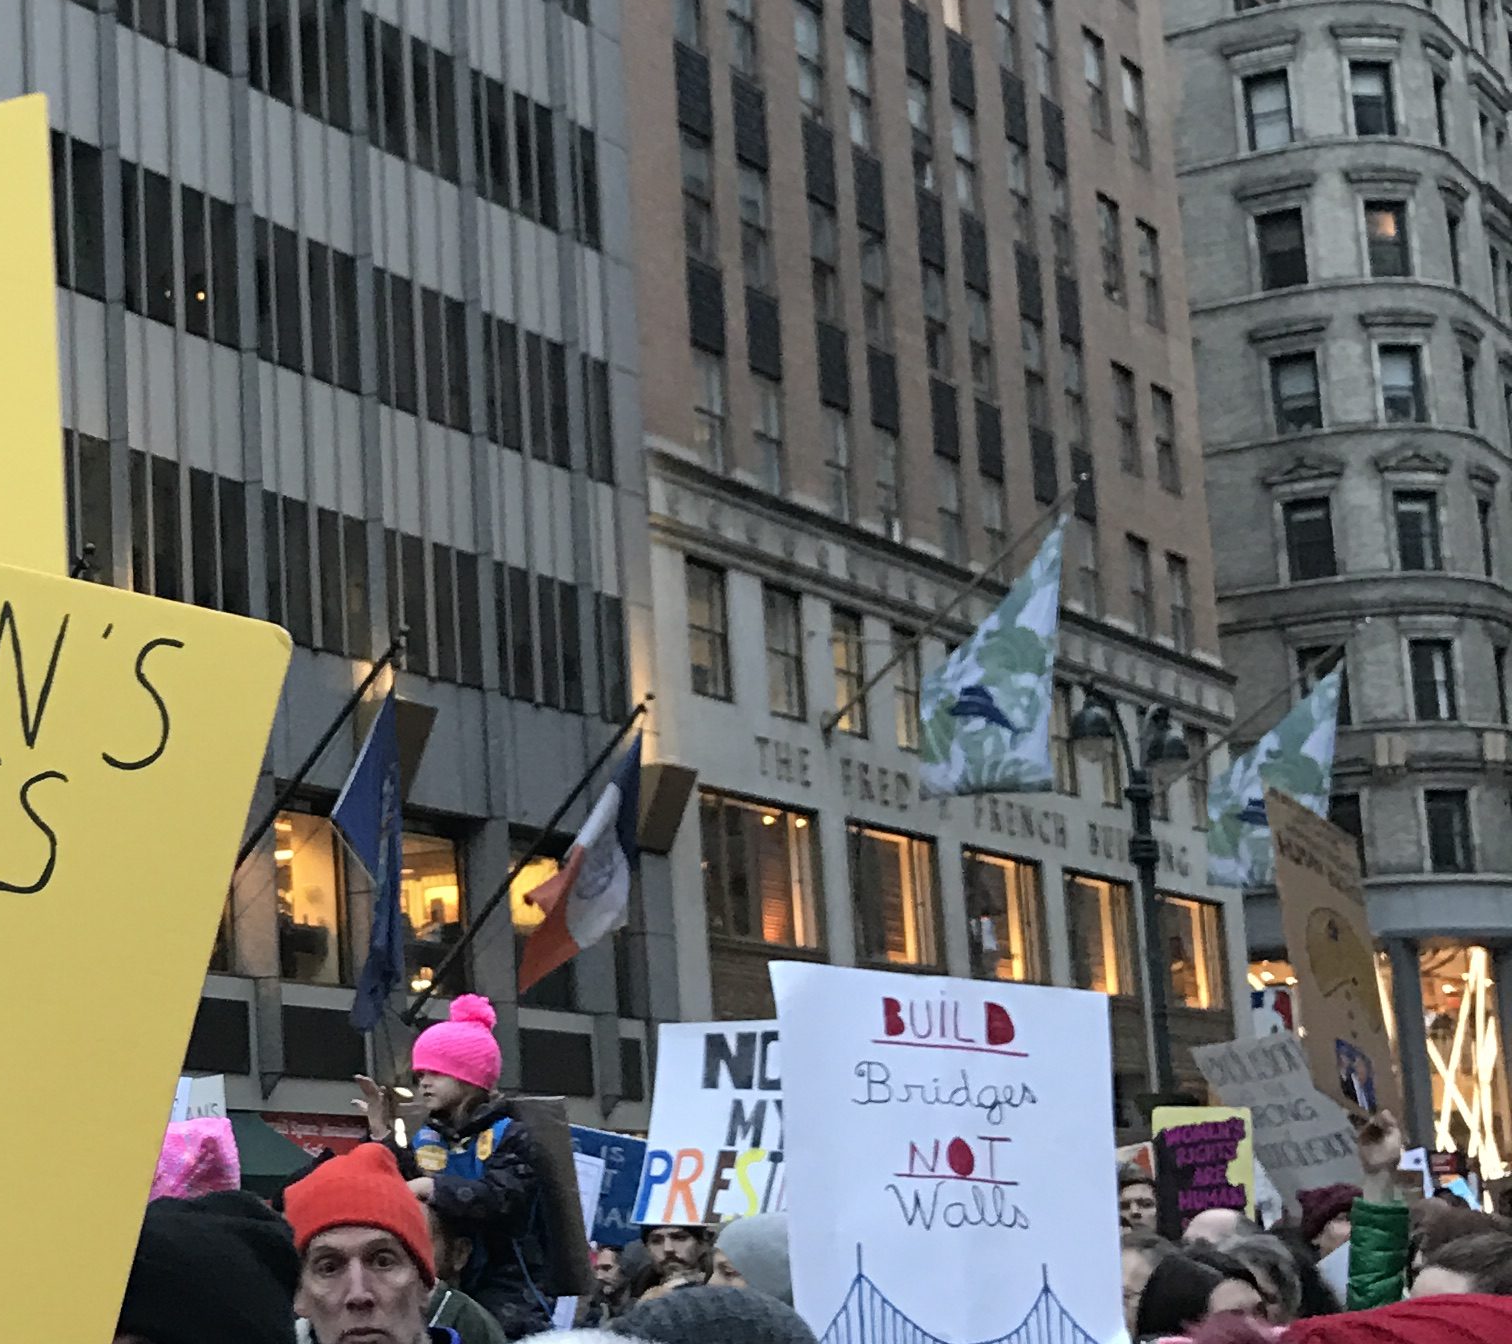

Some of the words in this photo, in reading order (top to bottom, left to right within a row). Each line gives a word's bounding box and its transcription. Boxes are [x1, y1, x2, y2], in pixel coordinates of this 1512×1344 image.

[754, 735, 812, 788] THE
[840, 757, 911, 811] FRED
[851, 1060, 1038, 1126] Bridges
[908, 1136, 1012, 1179] NOT
[884, 1180, 1030, 1231] Walls
